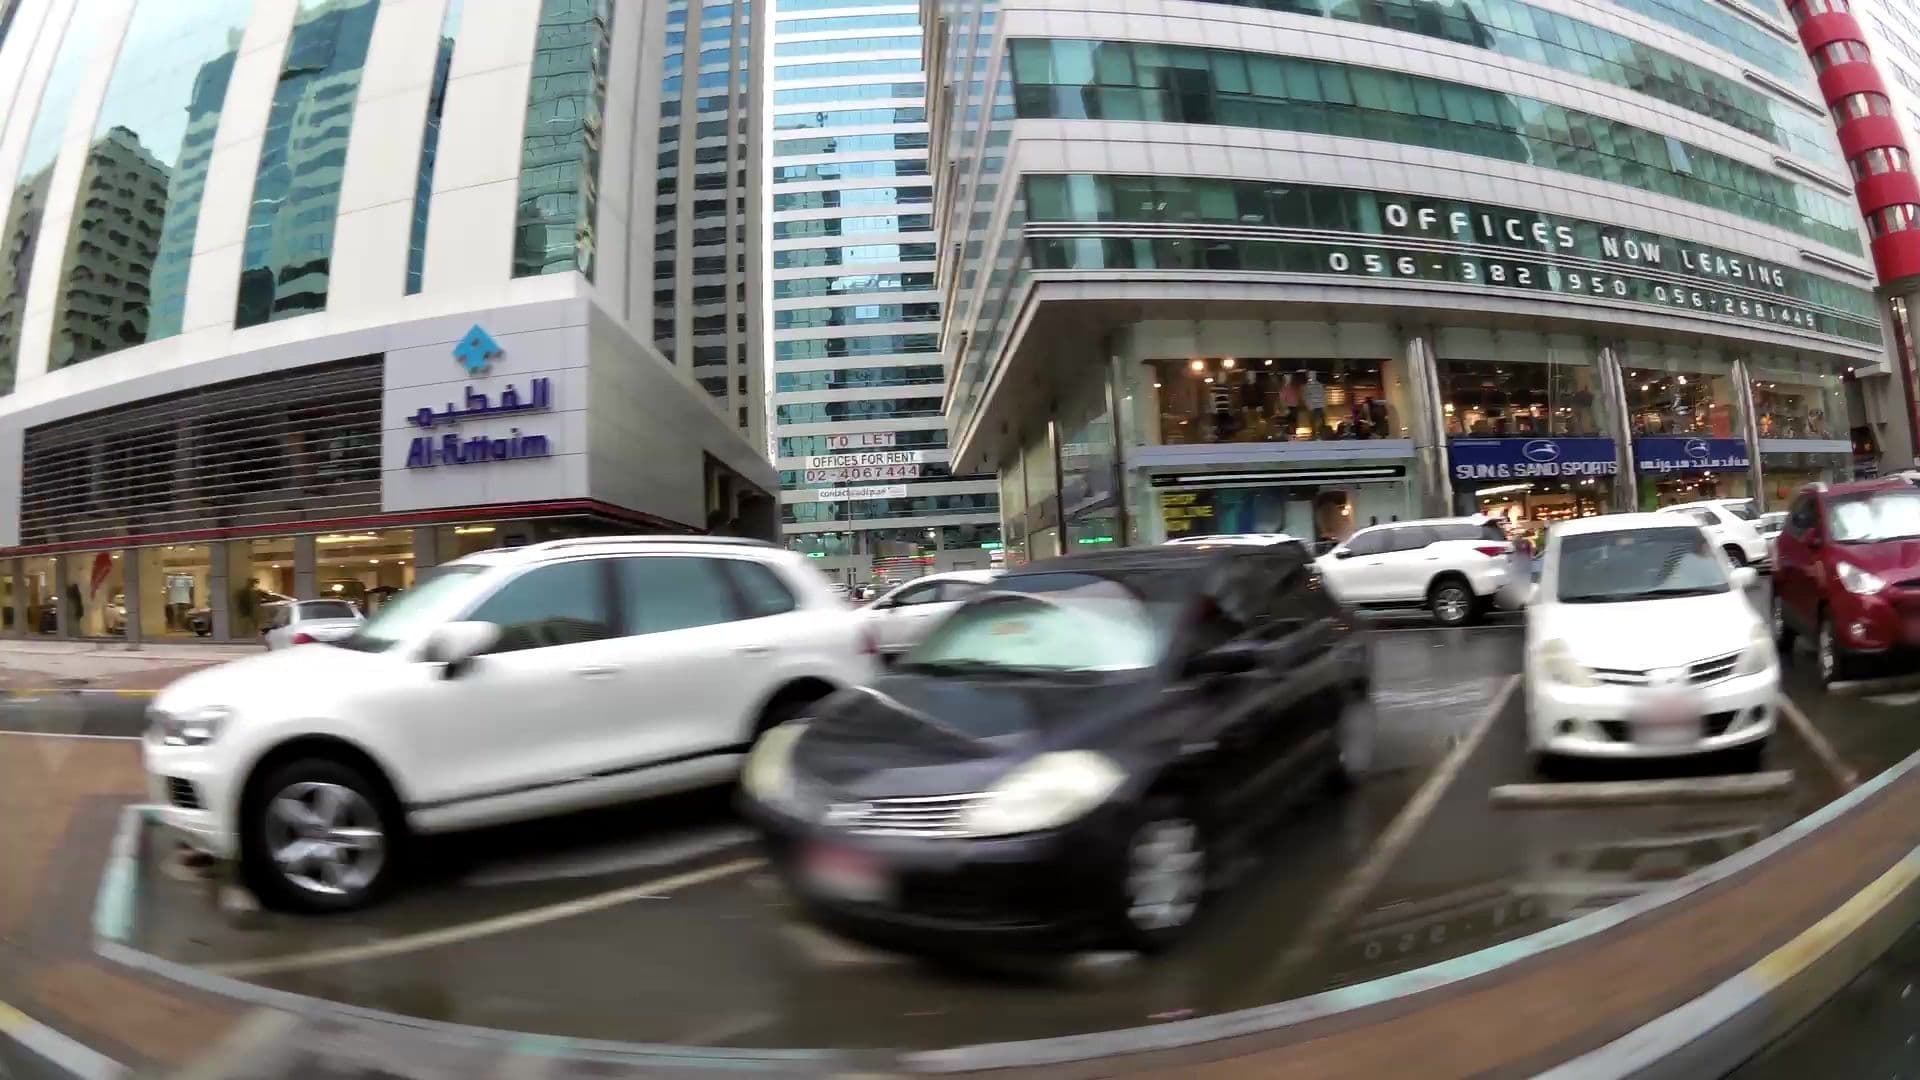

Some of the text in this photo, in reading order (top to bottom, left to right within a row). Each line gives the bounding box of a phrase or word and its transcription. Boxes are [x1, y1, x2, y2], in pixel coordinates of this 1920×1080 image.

[1385, 204, 1784, 287] OFFICES NOW LEASING
[407, 377, 550, 428] الفطيم
[406, 428, 549, 468] Al-Futtaim
[829, 433, 894, 447] TO LET
[813, 452, 915, 467] OFFICES FOR RENT
[807, 466, 918, 481] 02-4067444
[1455, 461, 1617, 480] SUN & SAND SPORTS
